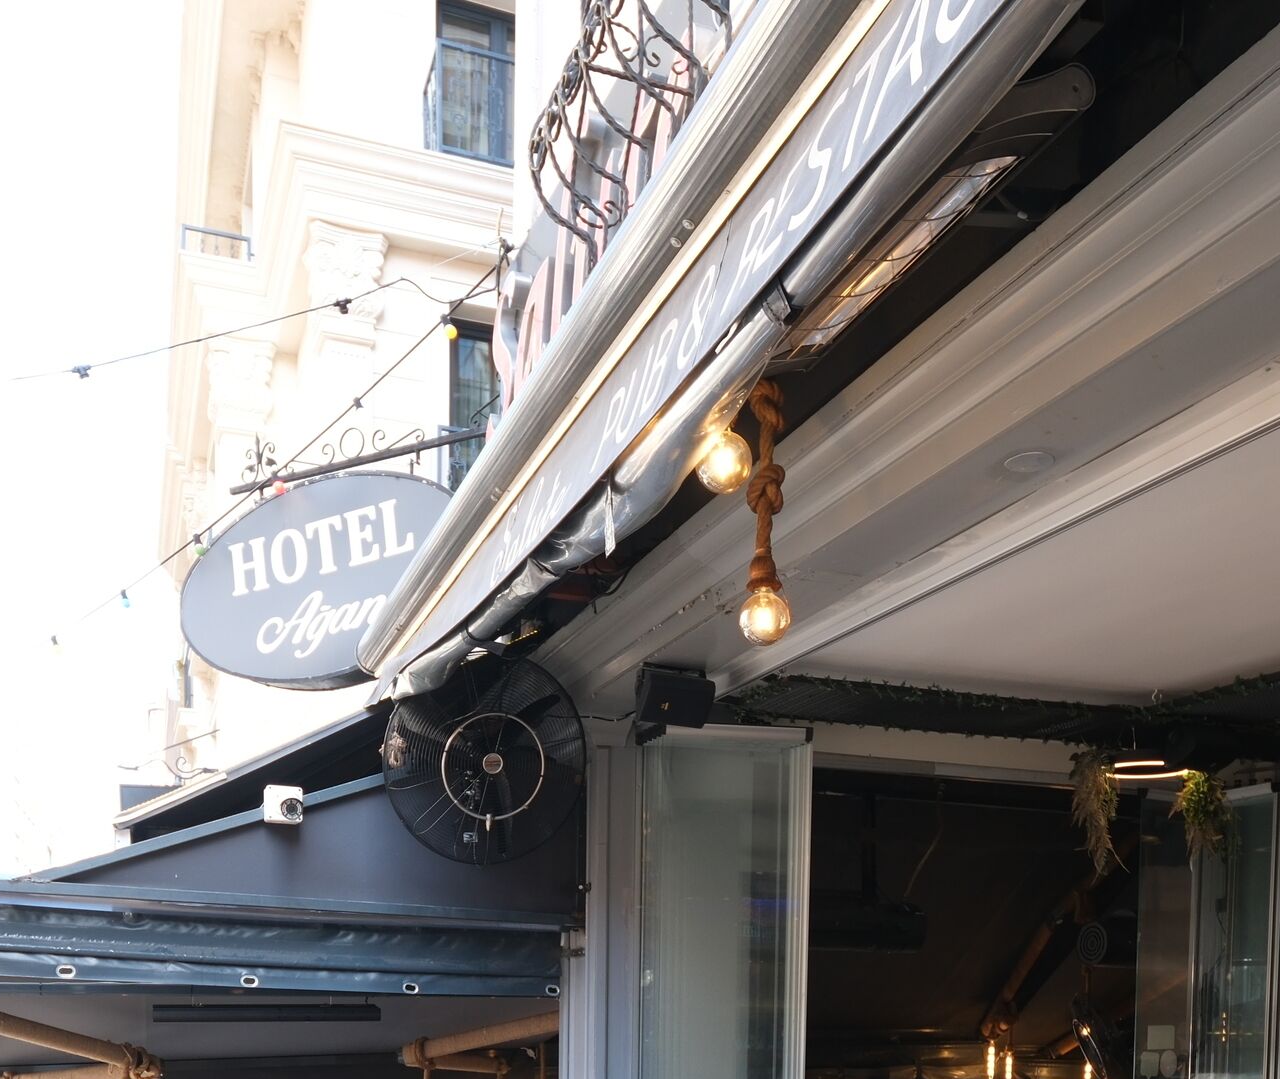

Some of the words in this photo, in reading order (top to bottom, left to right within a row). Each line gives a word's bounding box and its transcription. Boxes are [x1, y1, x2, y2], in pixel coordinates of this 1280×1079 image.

[589, 326, 677, 474] PUB
[676, 265, 717, 370] &
[228, 498, 414, 597] HOTEL
